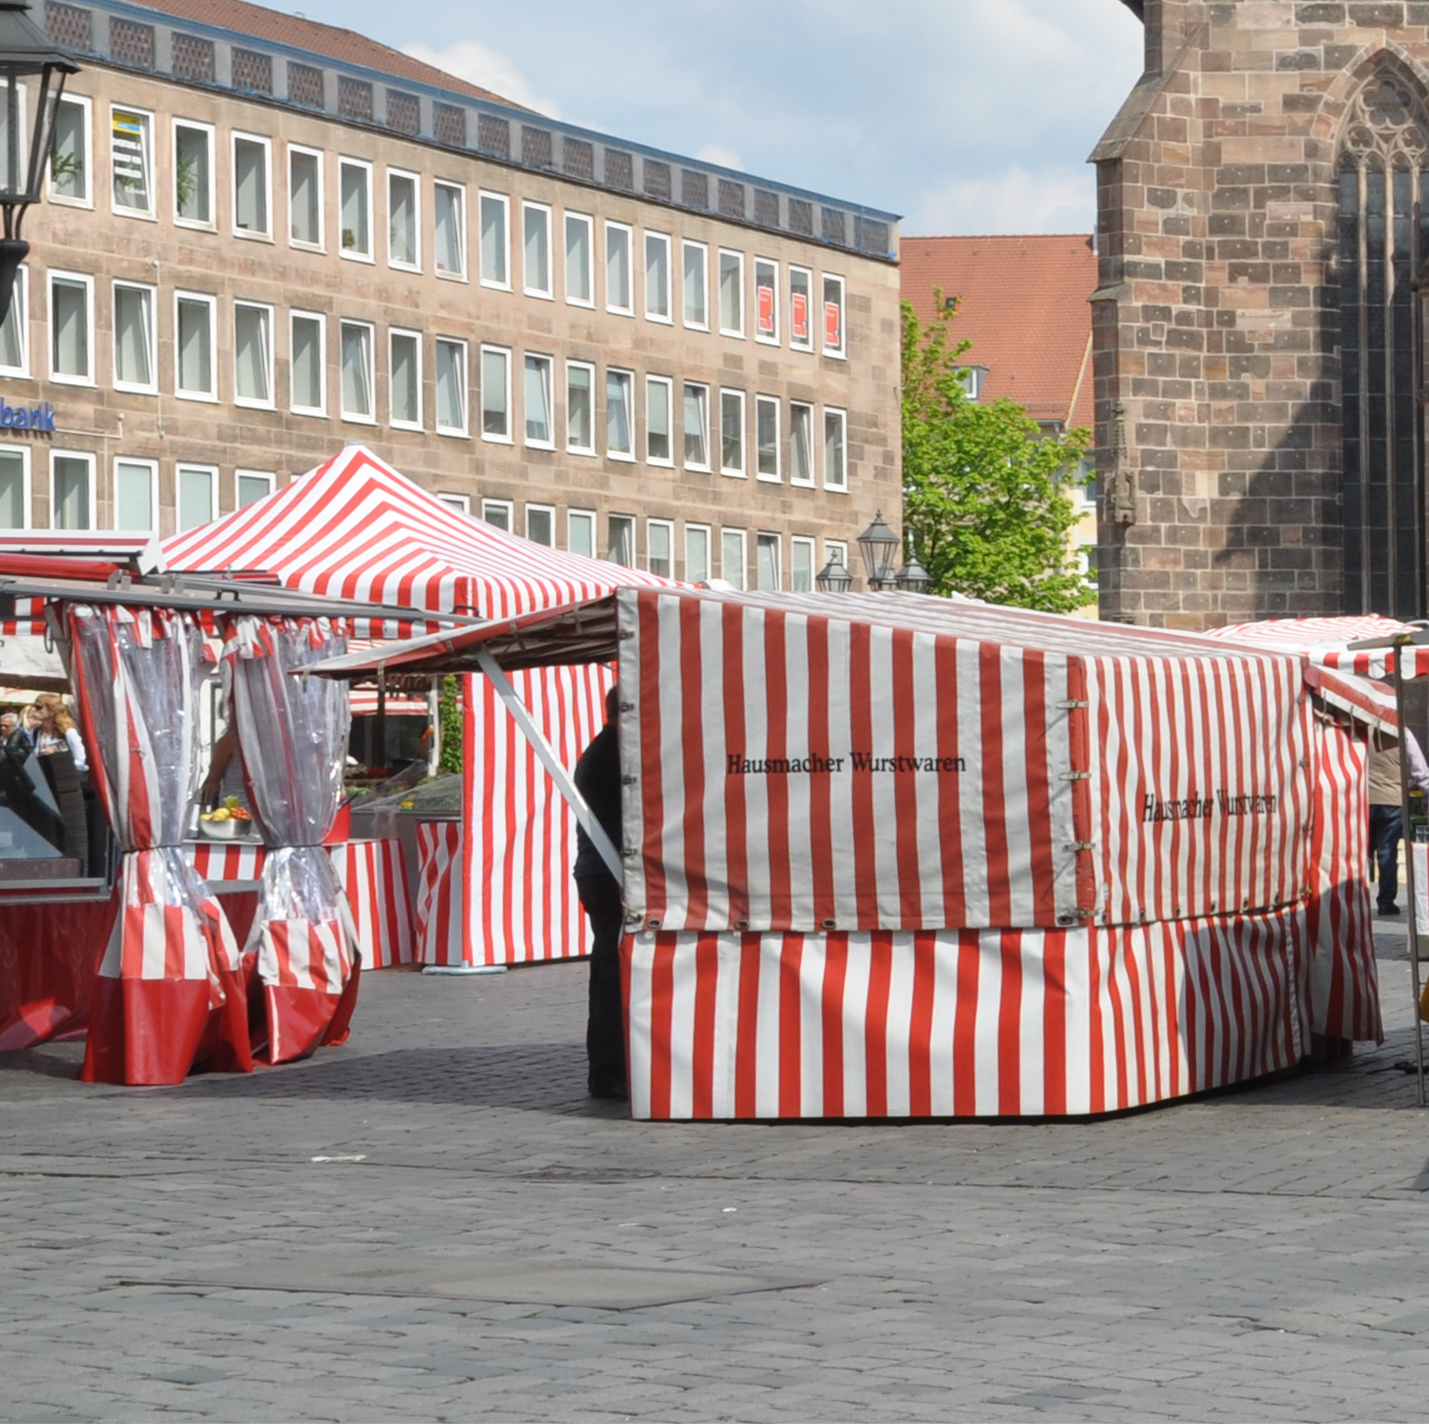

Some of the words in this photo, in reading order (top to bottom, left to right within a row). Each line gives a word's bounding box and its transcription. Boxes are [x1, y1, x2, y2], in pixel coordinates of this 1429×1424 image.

[0, 397, 57, 432] bank
[726, 752, 844, 775] Hausmacher
[850, 751, 967, 774] Wurstwaren
[1142, 791, 1214, 823] Hausmacher
[1216, 788, 1277, 817] Wurstwaren
